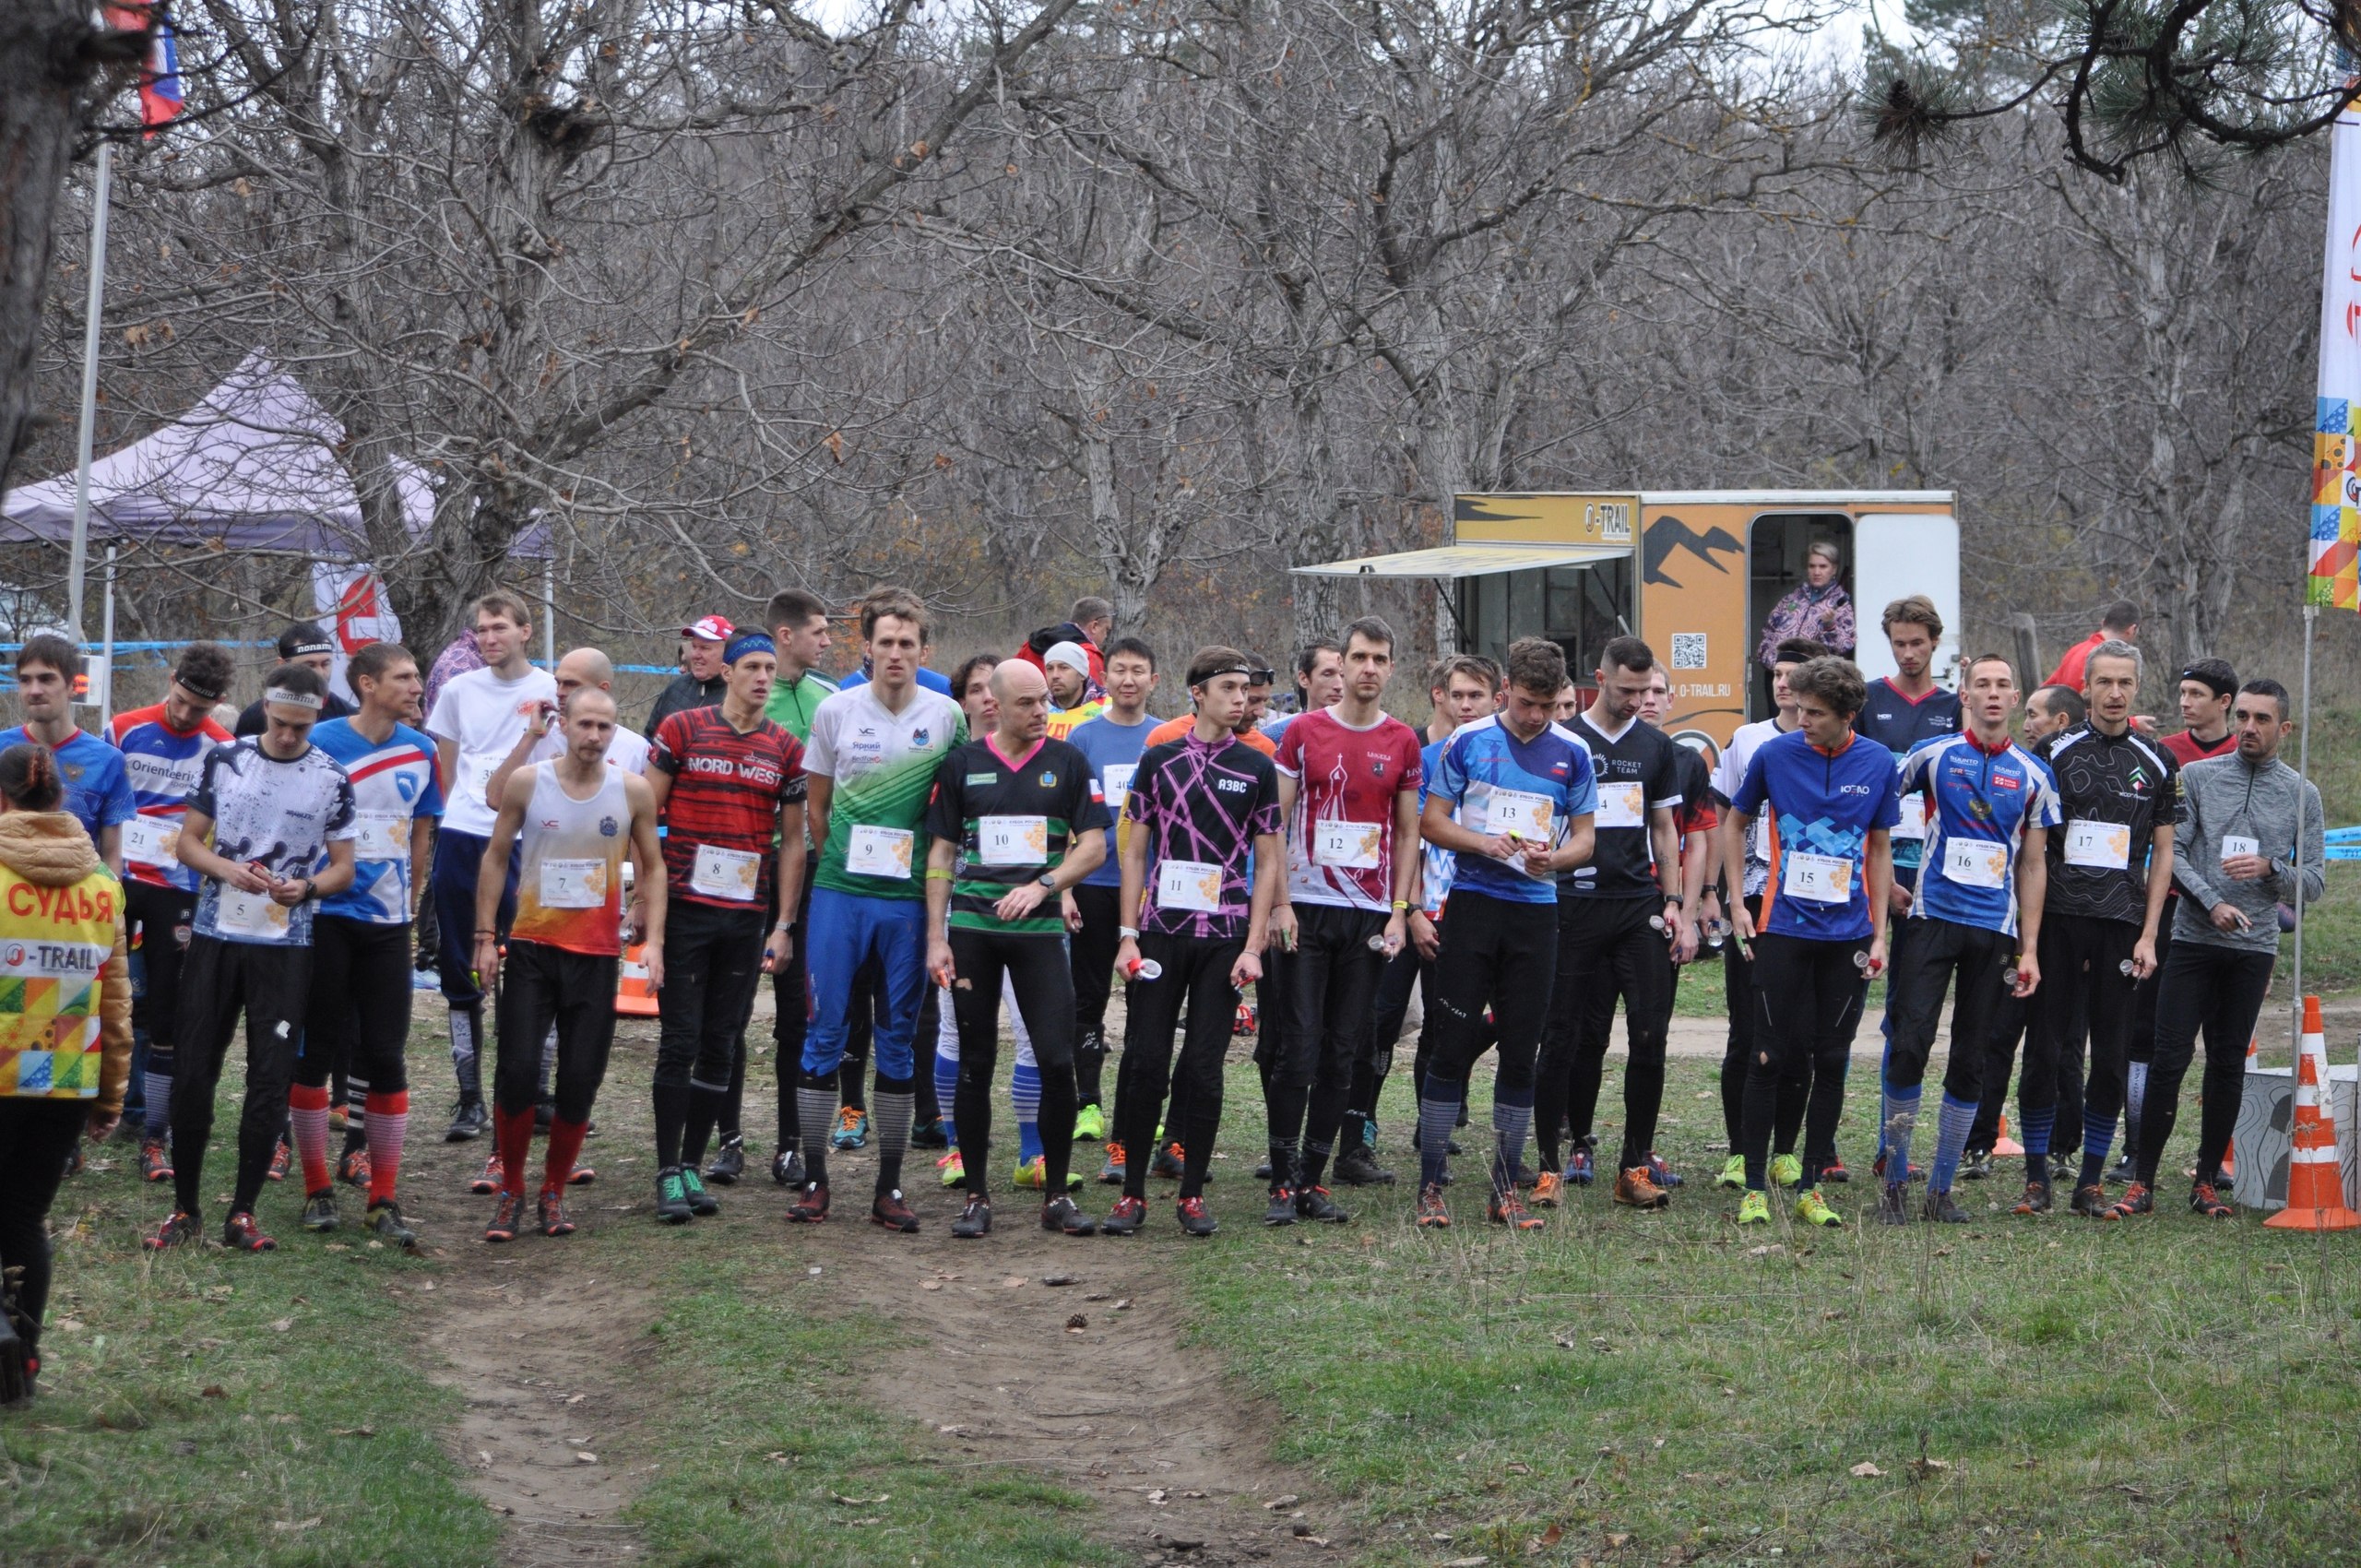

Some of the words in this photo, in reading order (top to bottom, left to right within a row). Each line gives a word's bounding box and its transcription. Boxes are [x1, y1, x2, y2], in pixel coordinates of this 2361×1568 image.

[1679, 684, 1731, 697] O-TRAIL.RU
[275, 691, 315, 705] noname
[852, 742, 881, 752] Яркий
[1611, 759, 1642, 768] ROCKET
[1950, 755, 1979, 765] SUUNTO
[132, 760, 196, 781] Orienteeri
[689, 757, 733, 775] NORD
[739, 763, 782, 786] WEST
[1617, 766, 1638, 775] TEAM
[782, 782, 809, 797] NOR
[1600, 799, 1608, 810] 4
[1502, 806, 1516, 819] 13
[131, 832, 145, 845] 21
[362, 829, 370, 841] 6
[995, 834, 1009, 846] 10
[1329, 837, 1343, 849] 12
[2079, 836, 2093, 847] 17
[2233, 842, 2247, 853] 18
[865, 844, 872, 855] 9
[1957, 856, 1971, 867] 16
[713, 863, 721, 874] 8
[559, 877, 566, 889] 7
[1800, 872, 1814, 884] 15
[1171, 880, 1181, 891] 11
[8, 883, 113, 925] СУДЬЯ
[236, 904, 245, 916] 5
